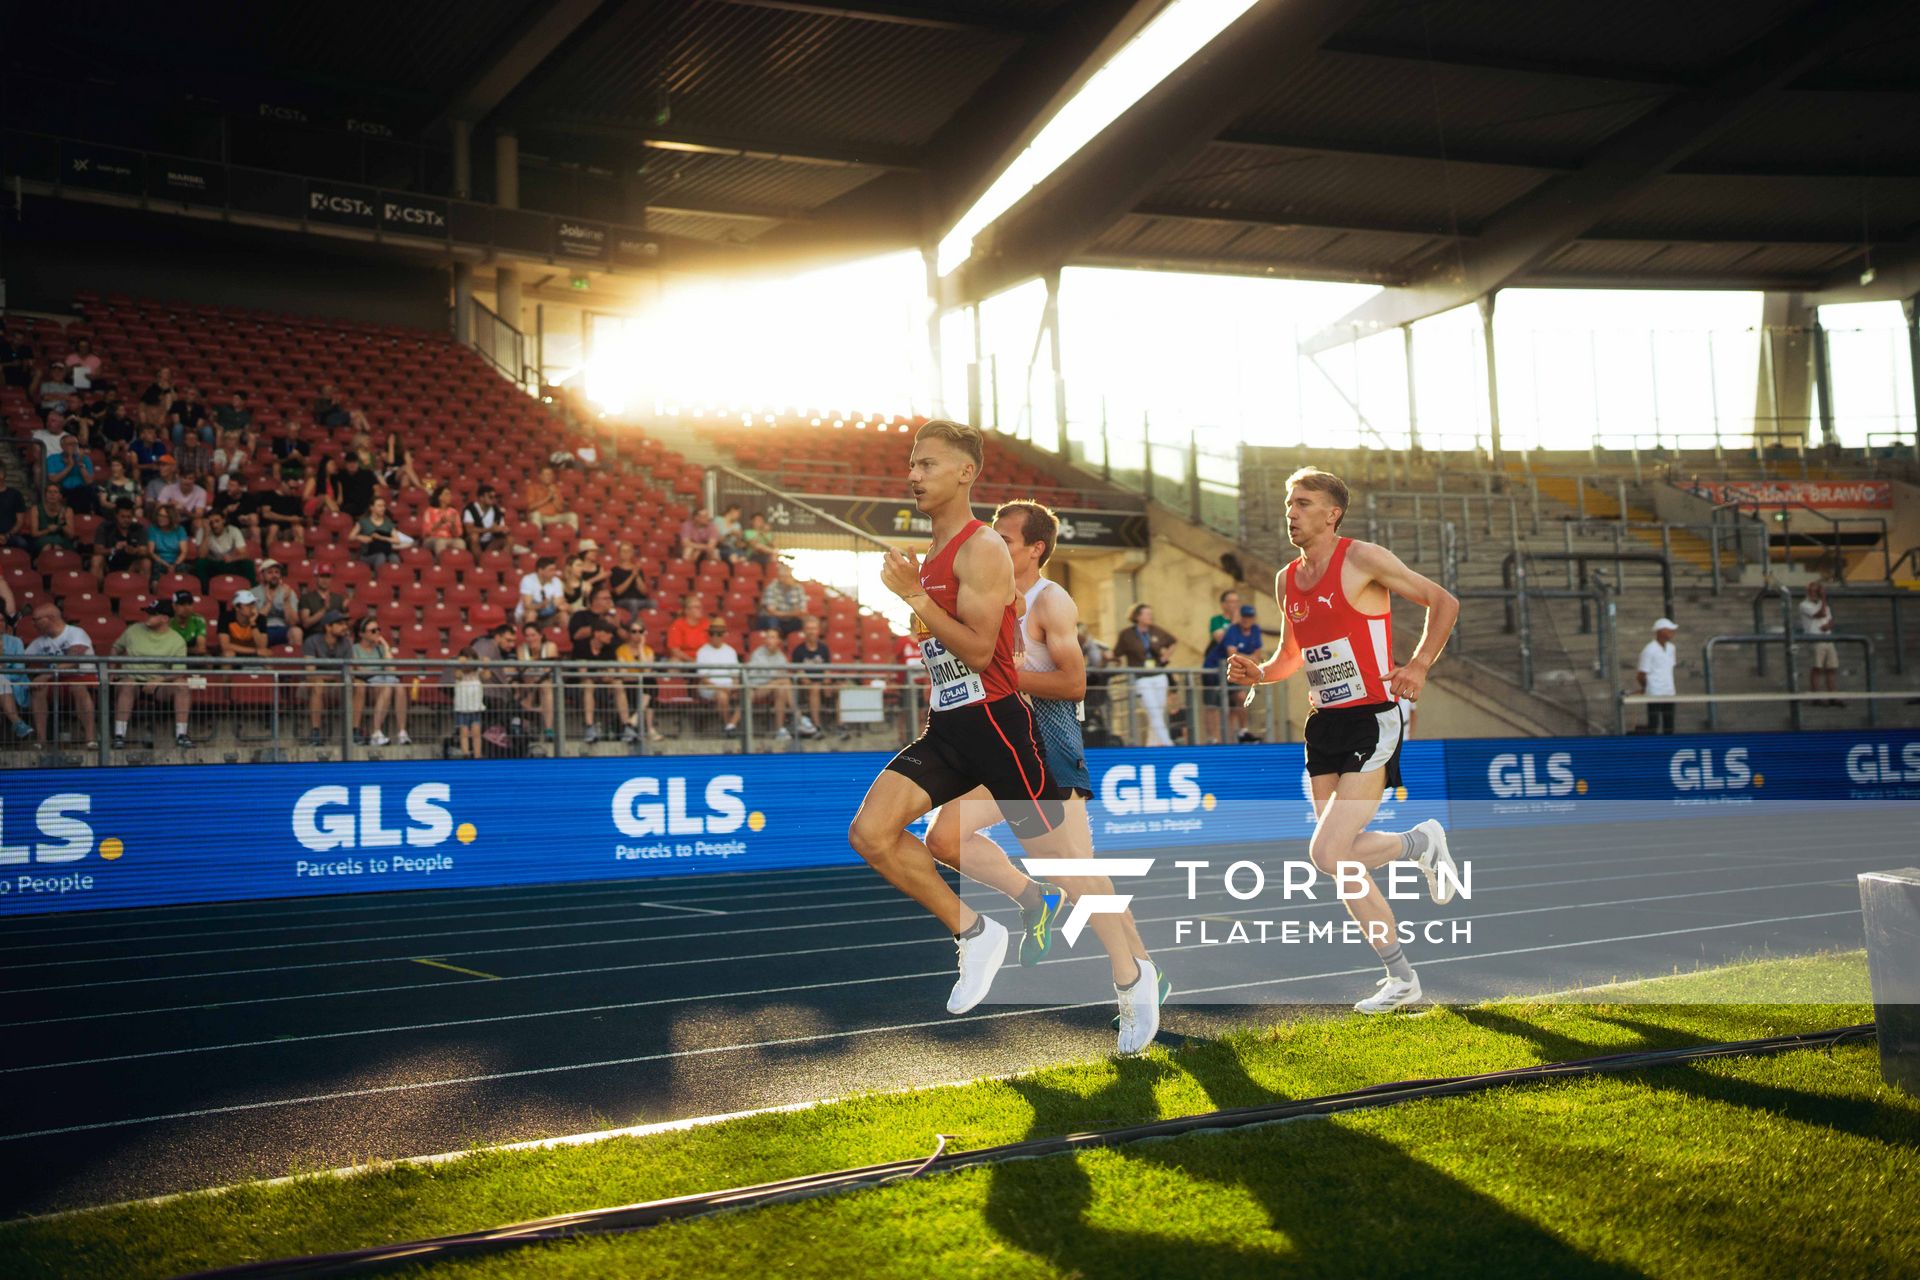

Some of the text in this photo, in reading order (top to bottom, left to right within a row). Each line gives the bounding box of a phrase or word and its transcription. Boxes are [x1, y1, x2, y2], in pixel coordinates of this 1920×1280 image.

[329, 196, 374, 217] CSTx
[403, 207, 445, 226] CSTx
[615, 839, 747, 860] Parcels to People
[296, 853, 453, 877] Parcels to People
[18, 872, 94, 894] People
